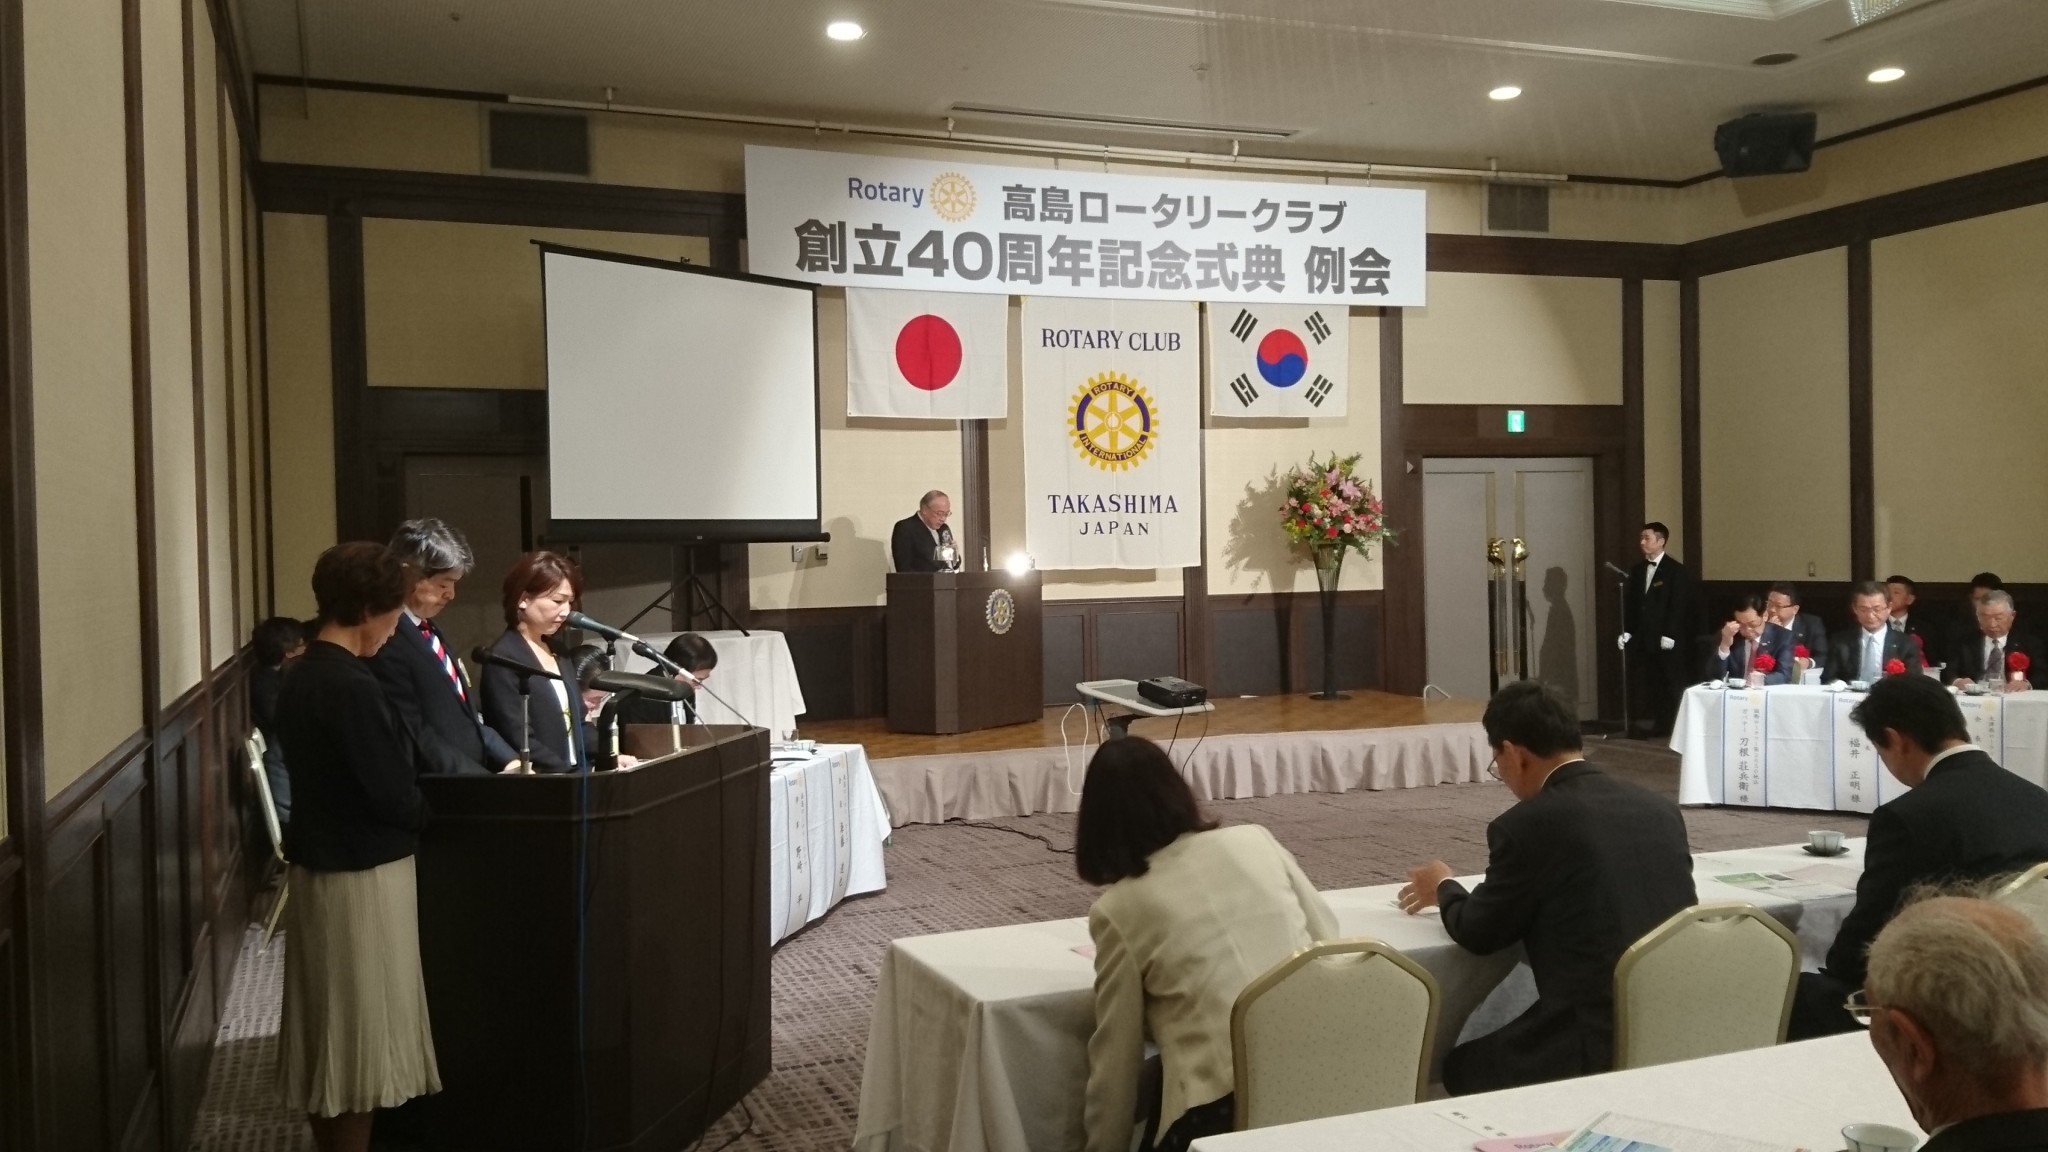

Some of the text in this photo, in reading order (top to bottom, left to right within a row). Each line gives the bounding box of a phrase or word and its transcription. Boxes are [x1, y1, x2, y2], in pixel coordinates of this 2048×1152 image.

[848, 177, 924, 208] Rotary
[1002, 184, 1346, 234] 高島ロータリークラブ
[795, 218, 1391, 296] 創立40周年記念式典 例会
[1042, 328, 1181, 352] ROTARY CLUB
[1093, 382, 1133, 395] ROTARY
[1081, 434, 1147, 461] INTERNATIONAL
[1047, 493, 1178, 514] TAKASHIMA
[1079, 520, 1149, 536] JAPAN
